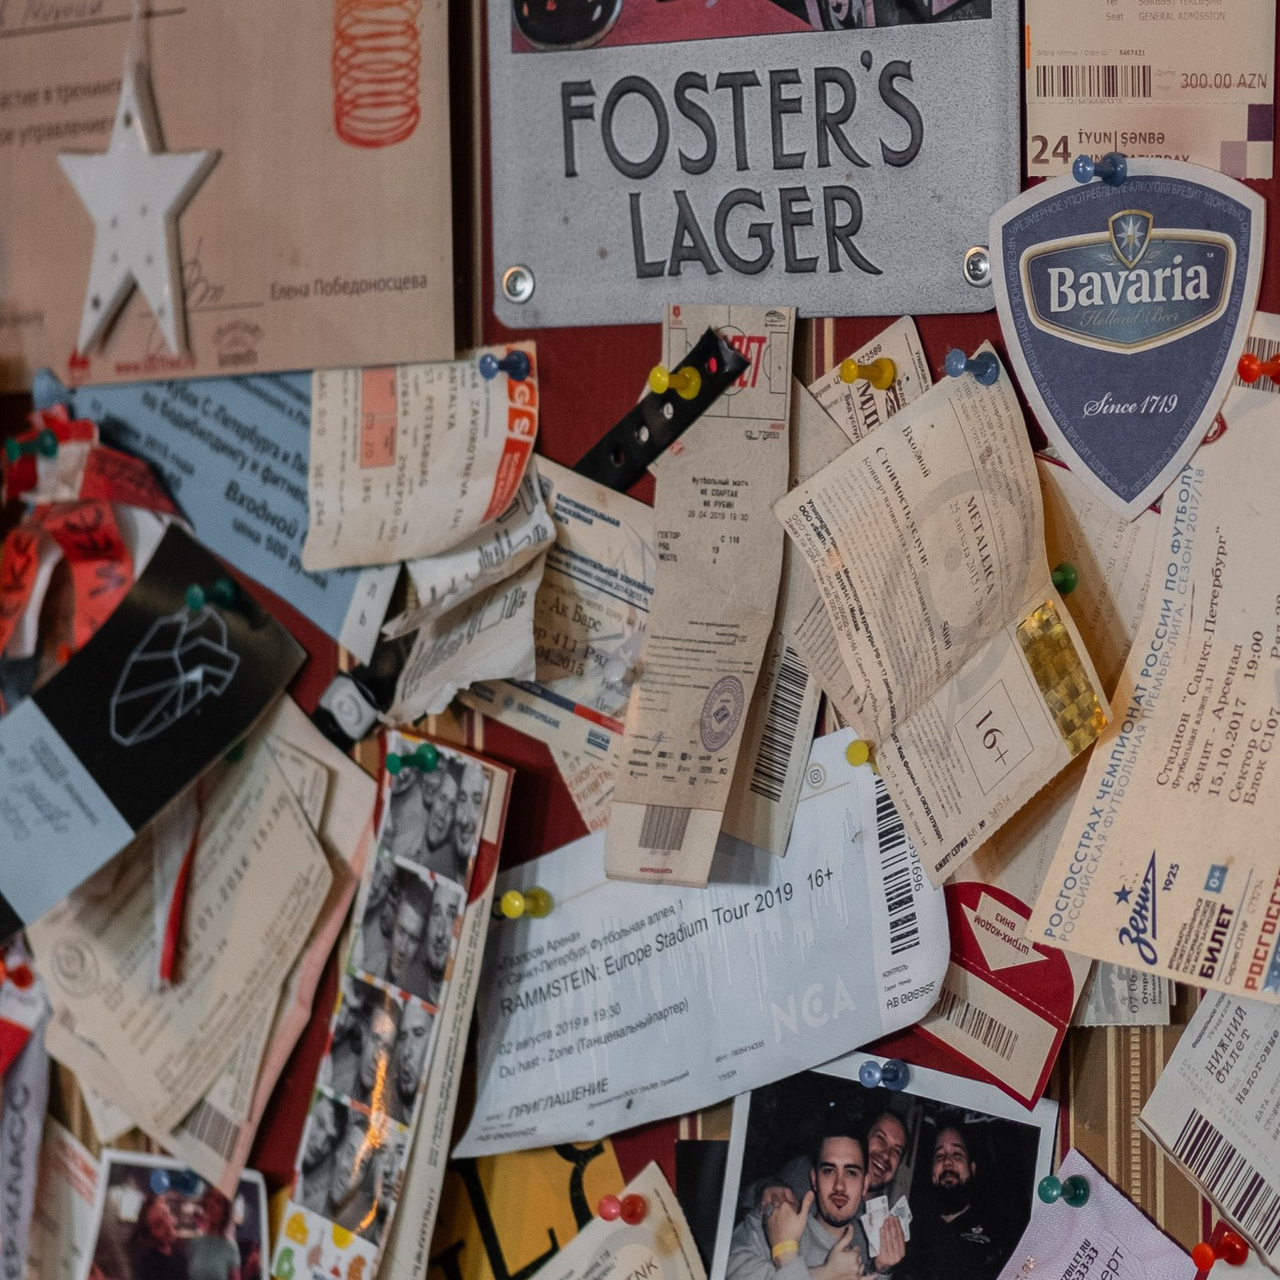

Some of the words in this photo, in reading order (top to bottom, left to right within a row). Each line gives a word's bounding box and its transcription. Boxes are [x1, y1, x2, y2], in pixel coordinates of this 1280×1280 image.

[1138, 10, 1177, 22] GENERAL
[561, 49, 925, 180] FOSTER'S
[1180, 72, 1233, 90] 300.00
[1237, 72, 1268, 90] AZN
[1030, 134, 1072, 165] 24
[629, 184, 885, 280] LAGER
[1047, 254, 1211, 314] Bavaria
[1083, 391, 1139, 420] Since
[1139, 393, 1179, 416] 1719
[710, 488, 739, 499] СПАРТАК
[713, 499, 736, 509] РУБИН
[875, 446, 912, 521] Стоимость
[1171, 462, 1194, 554] ФУТБОЛУ
[965, 494, 996, 596] METALLICA
[1164, 561, 1179, 590] ПО
[1139, 599, 1174, 680] РОССИИ
[1156, 711, 1191, 788] Стадион
[1181, 525, 1228, 703] "Санкт-Петербург"
[974, 709, 1010, 767] 16+
[1058, 832, 1109, 943] РОССИЙСКАЯ
[1102, 724, 1149, 829] ФУТБОЛЬНАЯ
[1177, 539, 1195, 596] СЕЗОН
[1096, 683, 1149, 801] ЧЕМПИОНАТ
[1187, 749, 1208, 794] Зенит
[1211, 643, 1243, 721] Арсенал
[1207, 696, 1248, 798] 15.10.2017
[1243, 629, 1264, 681] 19:00
[1228, 736, 1258, 804] Сектор
[1242, 757, 1267, 807] Блок
[1044, 806, 1104, 940] РОСГОССТРАХ
[1162, 862, 1180, 892] 1925
[500, 960, 602, 1017] RAMMSTEIN:
[604, 942, 653, 978] Europe
[655, 916, 709, 953] Stadium
[711, 902, 750, 928] Tour
[754, 881, 794, 914] 2019
[806, 866, 835, 892] 16+
[1198, 903, 1235, 980] БИЛЕТ
[508, 1077, 610, 1121] ПРИГЛАШЕНИЕ
